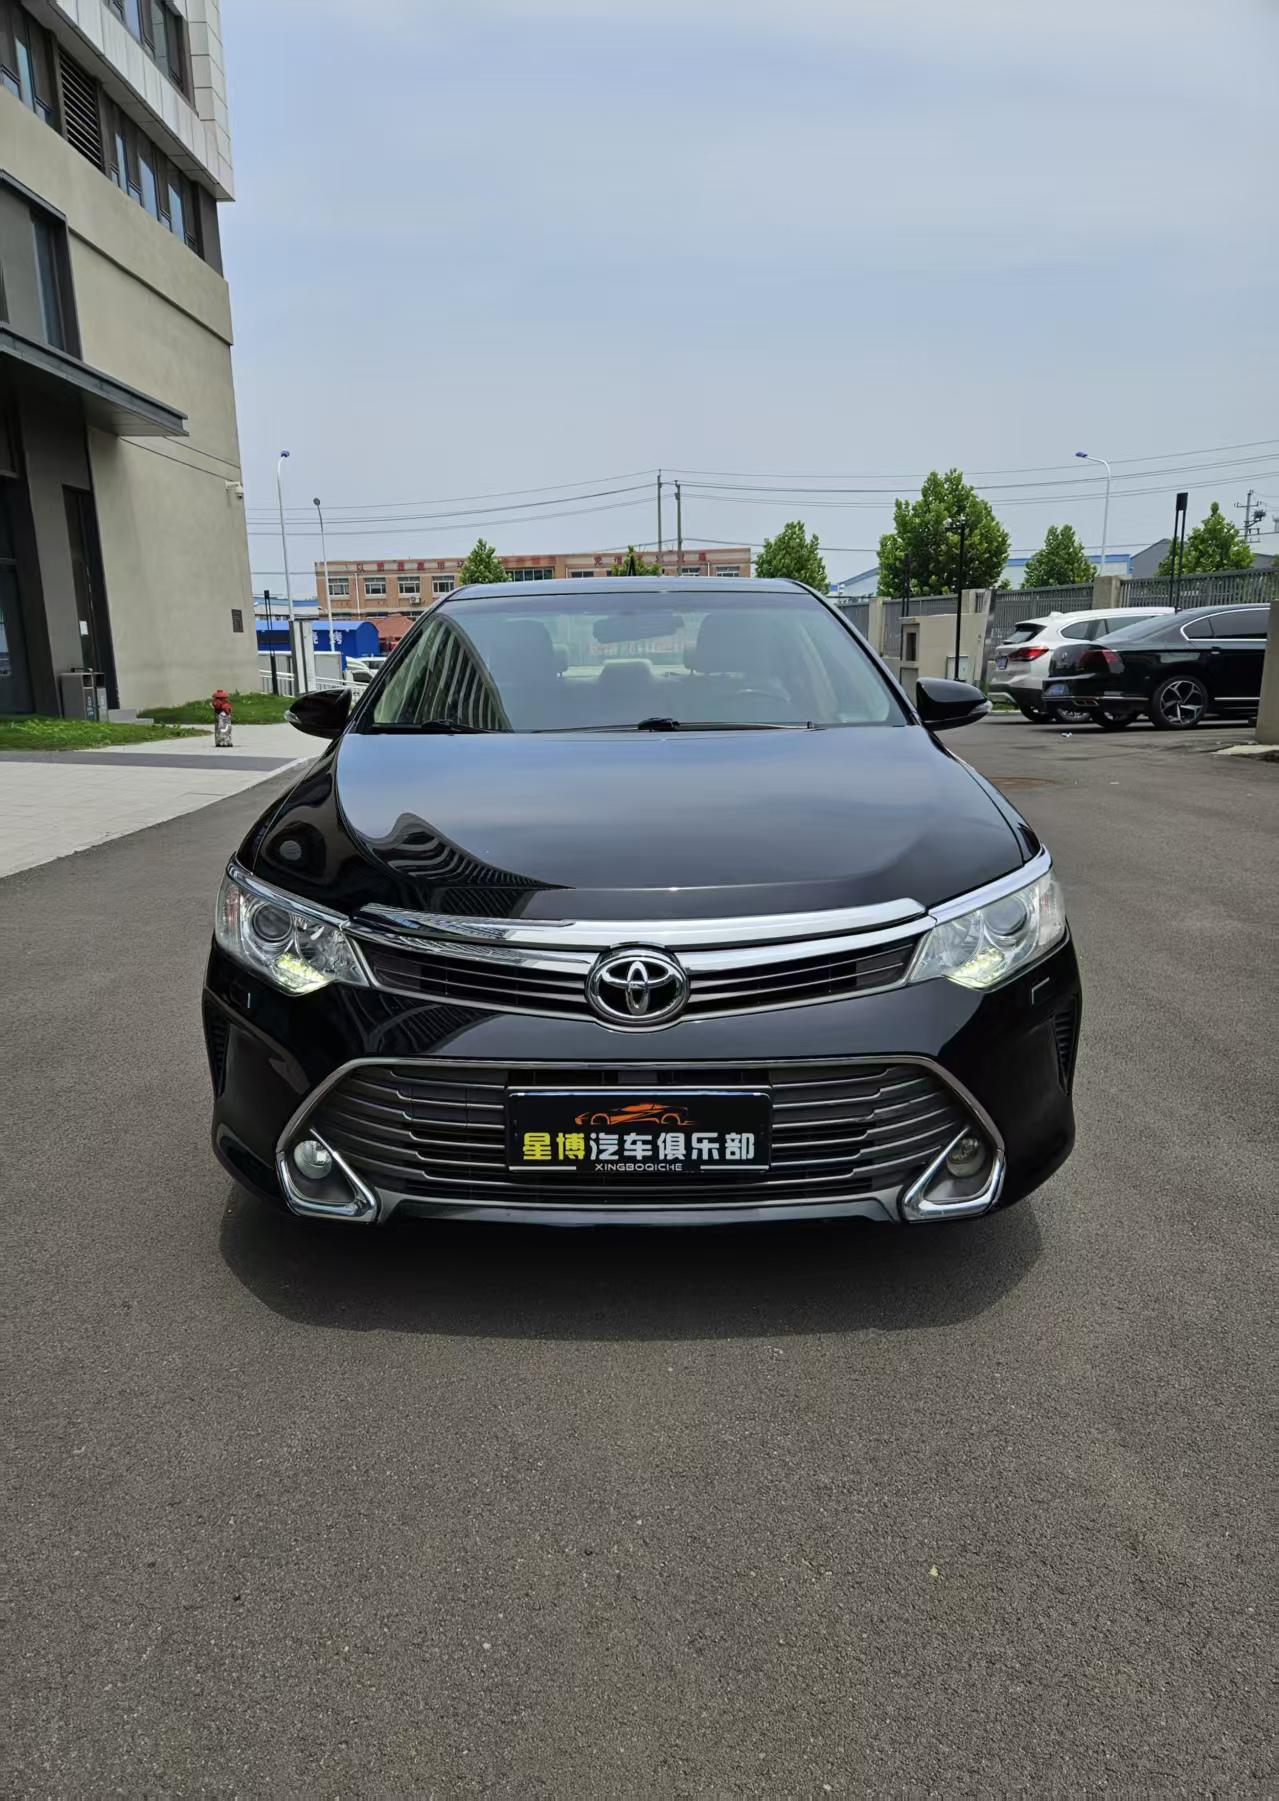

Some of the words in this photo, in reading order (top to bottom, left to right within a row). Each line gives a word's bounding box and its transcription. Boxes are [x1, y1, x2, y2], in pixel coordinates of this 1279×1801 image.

[523, 1132, 755, 1160] 星博汽车俱乐部
[595, 1163, 683, 1171] XINGBOQICHE
